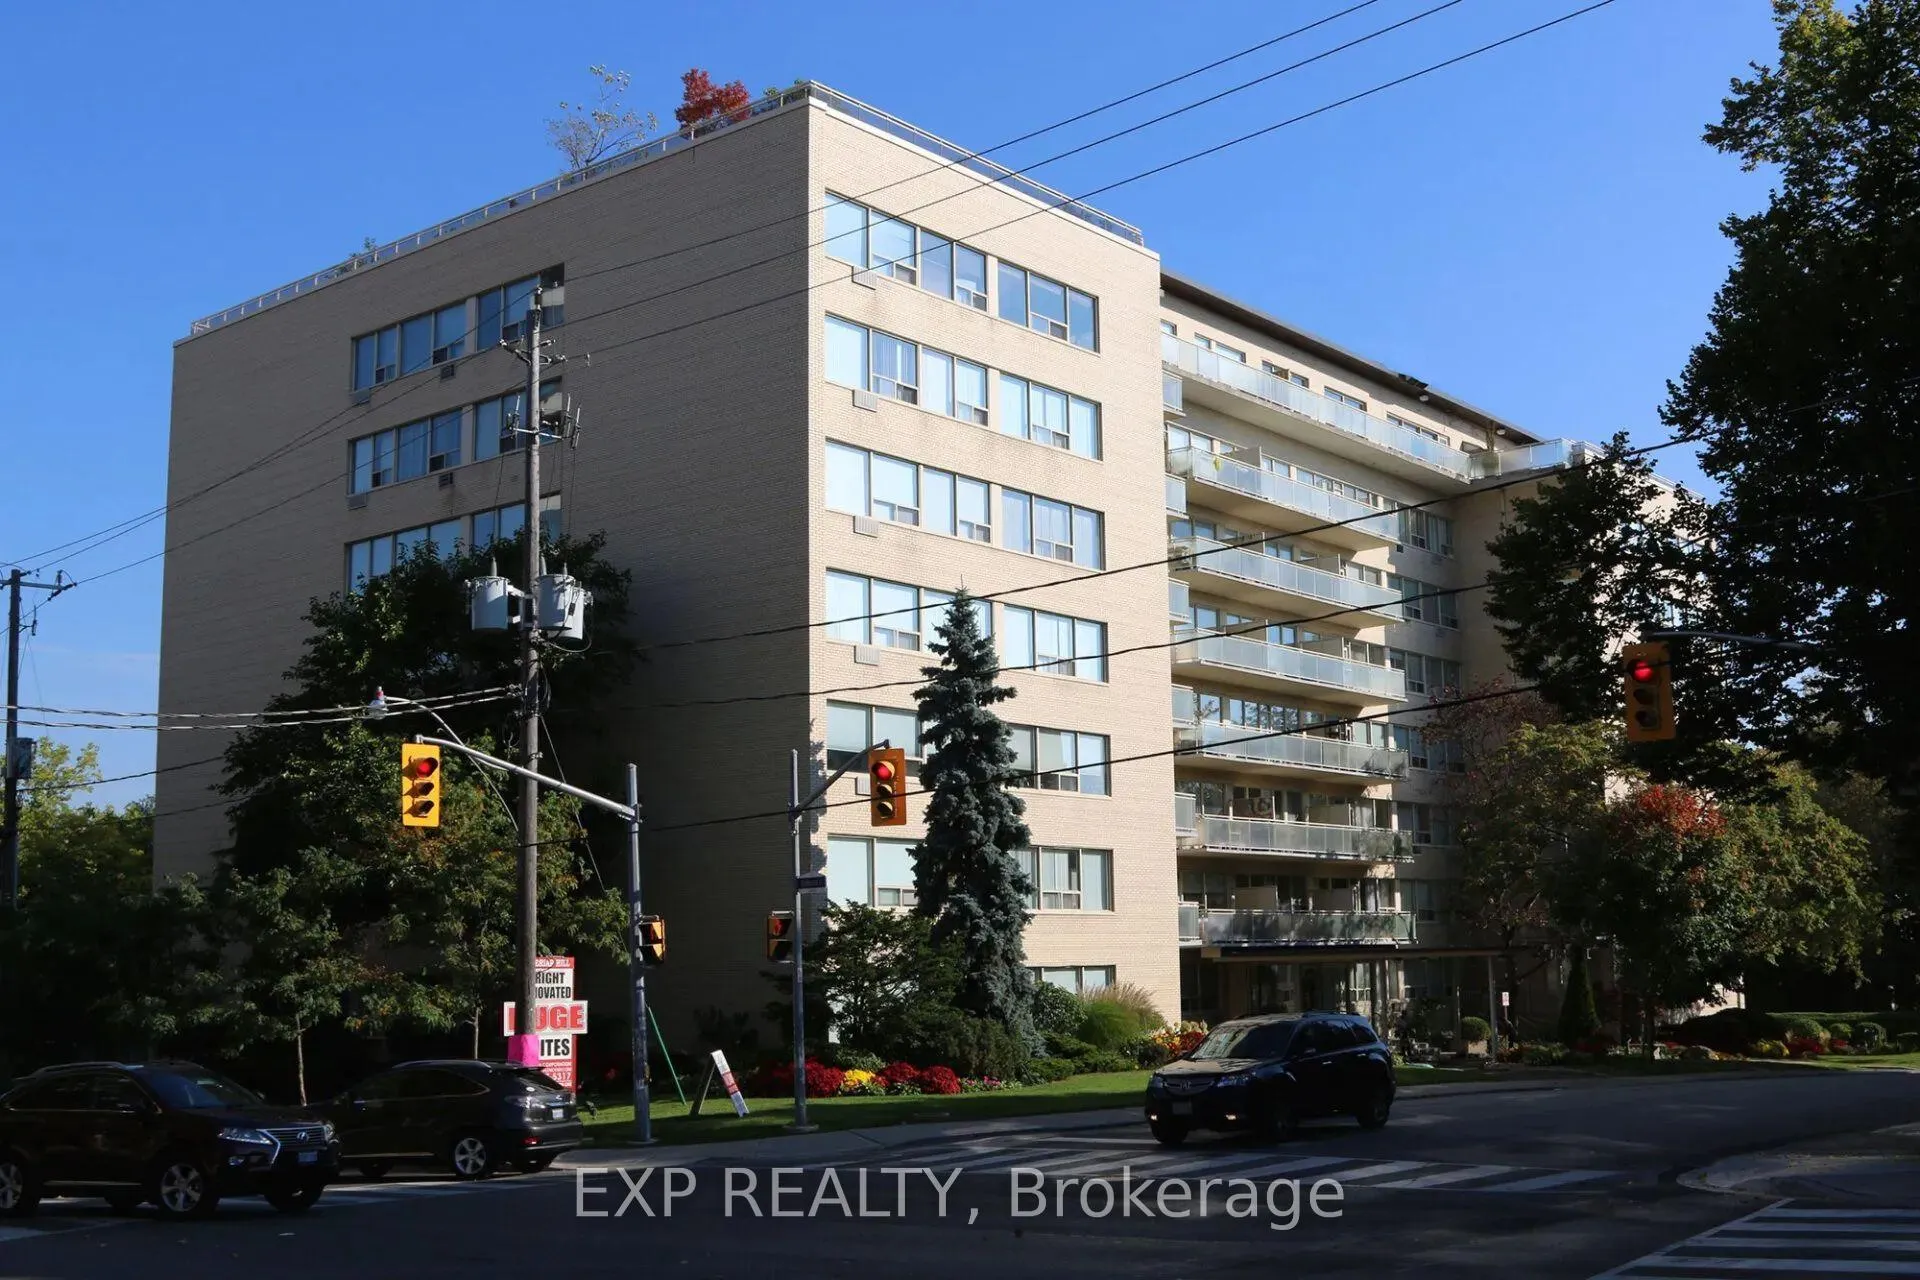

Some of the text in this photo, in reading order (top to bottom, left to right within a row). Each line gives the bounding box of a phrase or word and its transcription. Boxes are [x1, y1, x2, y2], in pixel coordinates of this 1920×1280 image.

[535, 972, 565, 984] RIGHT
[535, 986, 571, 999] OVATED
[540, 1038, 570, 1056] ITES
